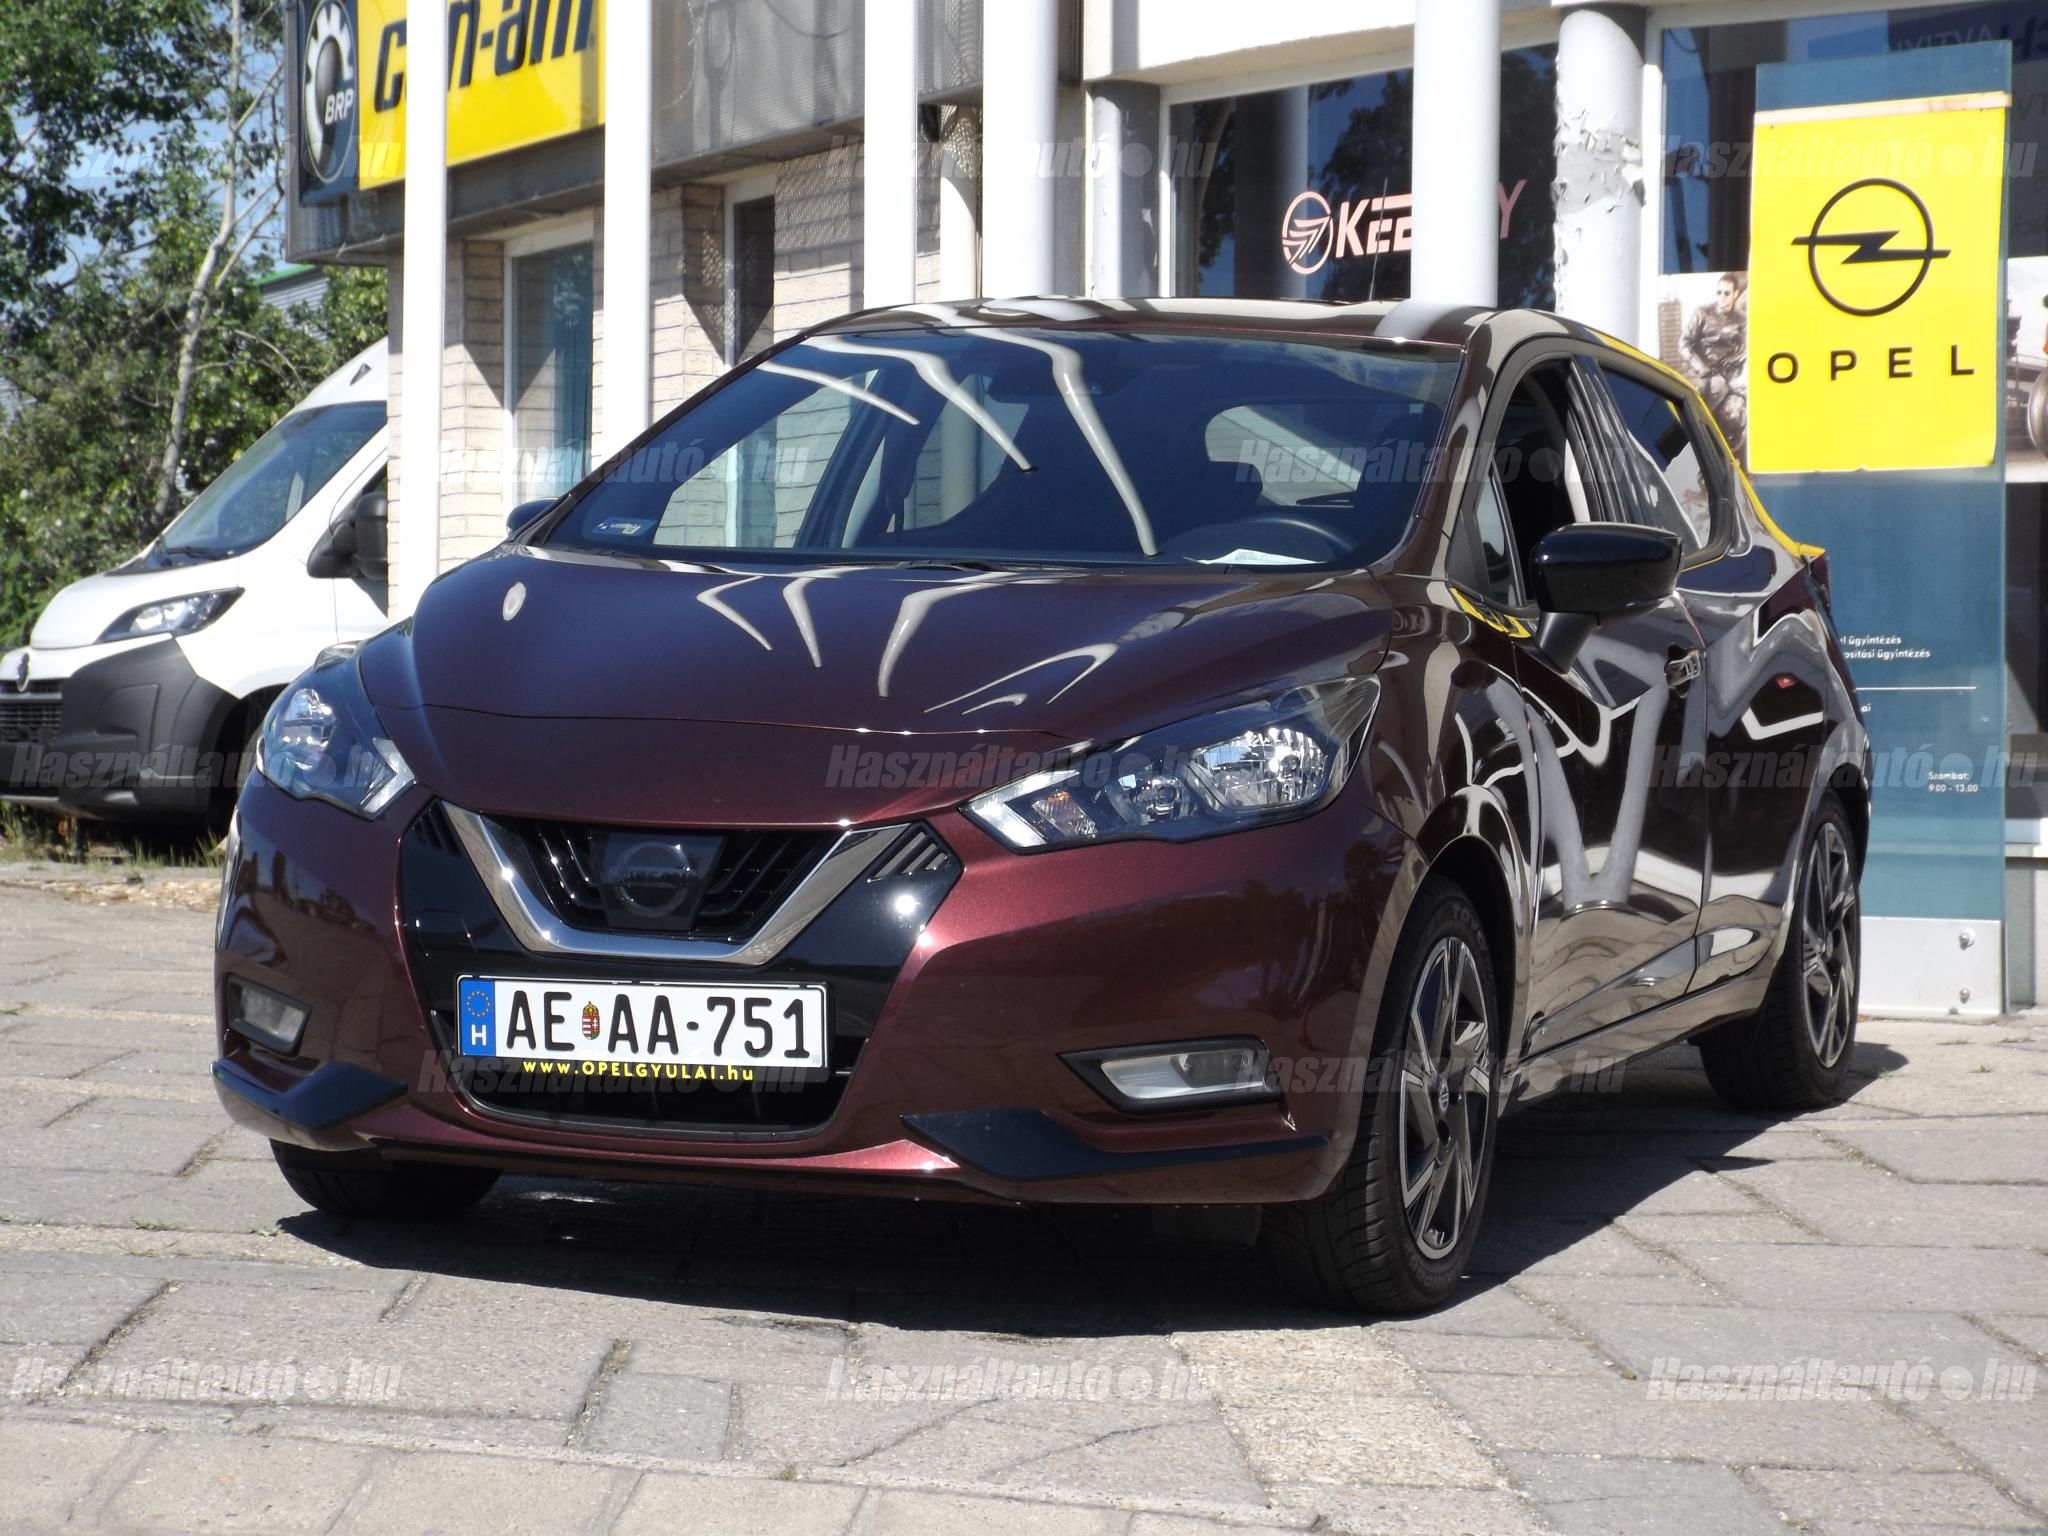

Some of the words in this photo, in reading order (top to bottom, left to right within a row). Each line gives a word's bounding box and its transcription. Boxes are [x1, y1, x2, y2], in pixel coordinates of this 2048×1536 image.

[373, 0, 592, 113] cn-am
[324, 88, 354, 125] BRP
[1335, 179, 1527, 259] KEEY
[1766, 344, 1976, 384] OPEL
[1844, 650, 1875, 659] osítási
[1877, 649, 1931, 661] ügyintézés
[1849, 635, 1902, 647] ügyintézés
[470, 1024, 487, 1047] H
[506, 989, 576, 1052] AE
[607, 992, 811, 1060] AA-751
[522, 1059, 755, 1082] www.OPELGYULAI.hu
